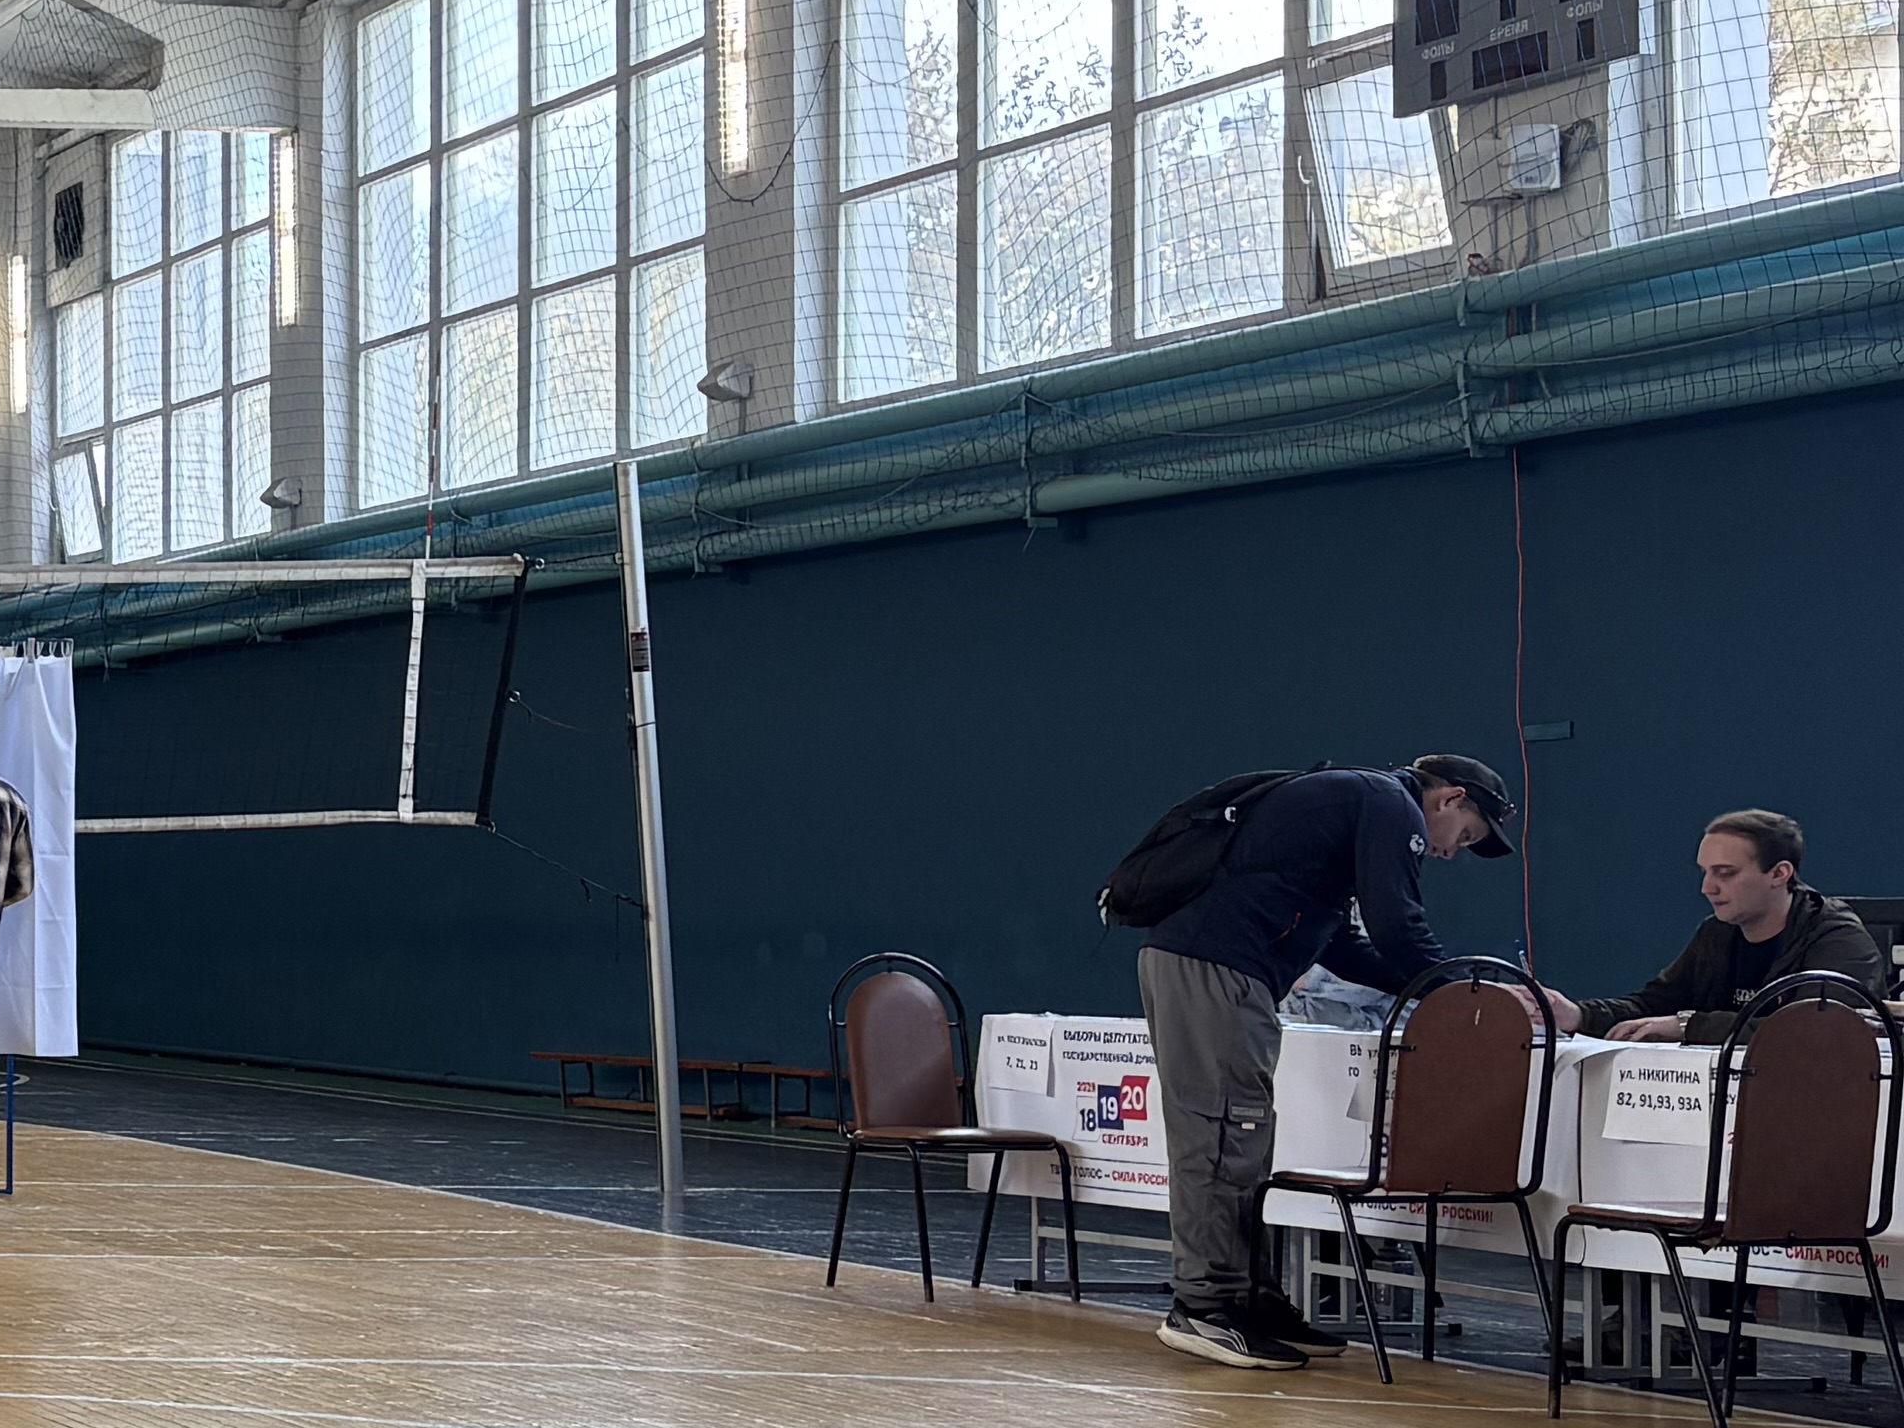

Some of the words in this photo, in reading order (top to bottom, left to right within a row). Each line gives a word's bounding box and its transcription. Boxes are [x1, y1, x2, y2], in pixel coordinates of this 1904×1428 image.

[1566, 0, 1604, 18] ФОЛЫ
[1421, 41, 1455, 60] ФОЛЫ
[1103, 1032, 1151, 1045] ДЕПУТАТО
[1619, 1069, 1635, 1082] ул.
[1638, 1068, 1700, 1085] НИКИТИНА
[1080, 1108, 1096, 1132] 18
[1100, 1096, 1118, 1121] 19
[1122, 1086, 1145, 1111] 20
[1616, 1092, 1636, 1109] 82,
[1677, 1096, 1702, 1112] 93А
[1112, 1170, 1137, 1183] СИЛА
[1442, 1205, 1494, 1224] РОССИИ!
[1785, 1245, 1822, 1263] СИЛА
[1826, 1248, 1890, 1269] РОССИ!
